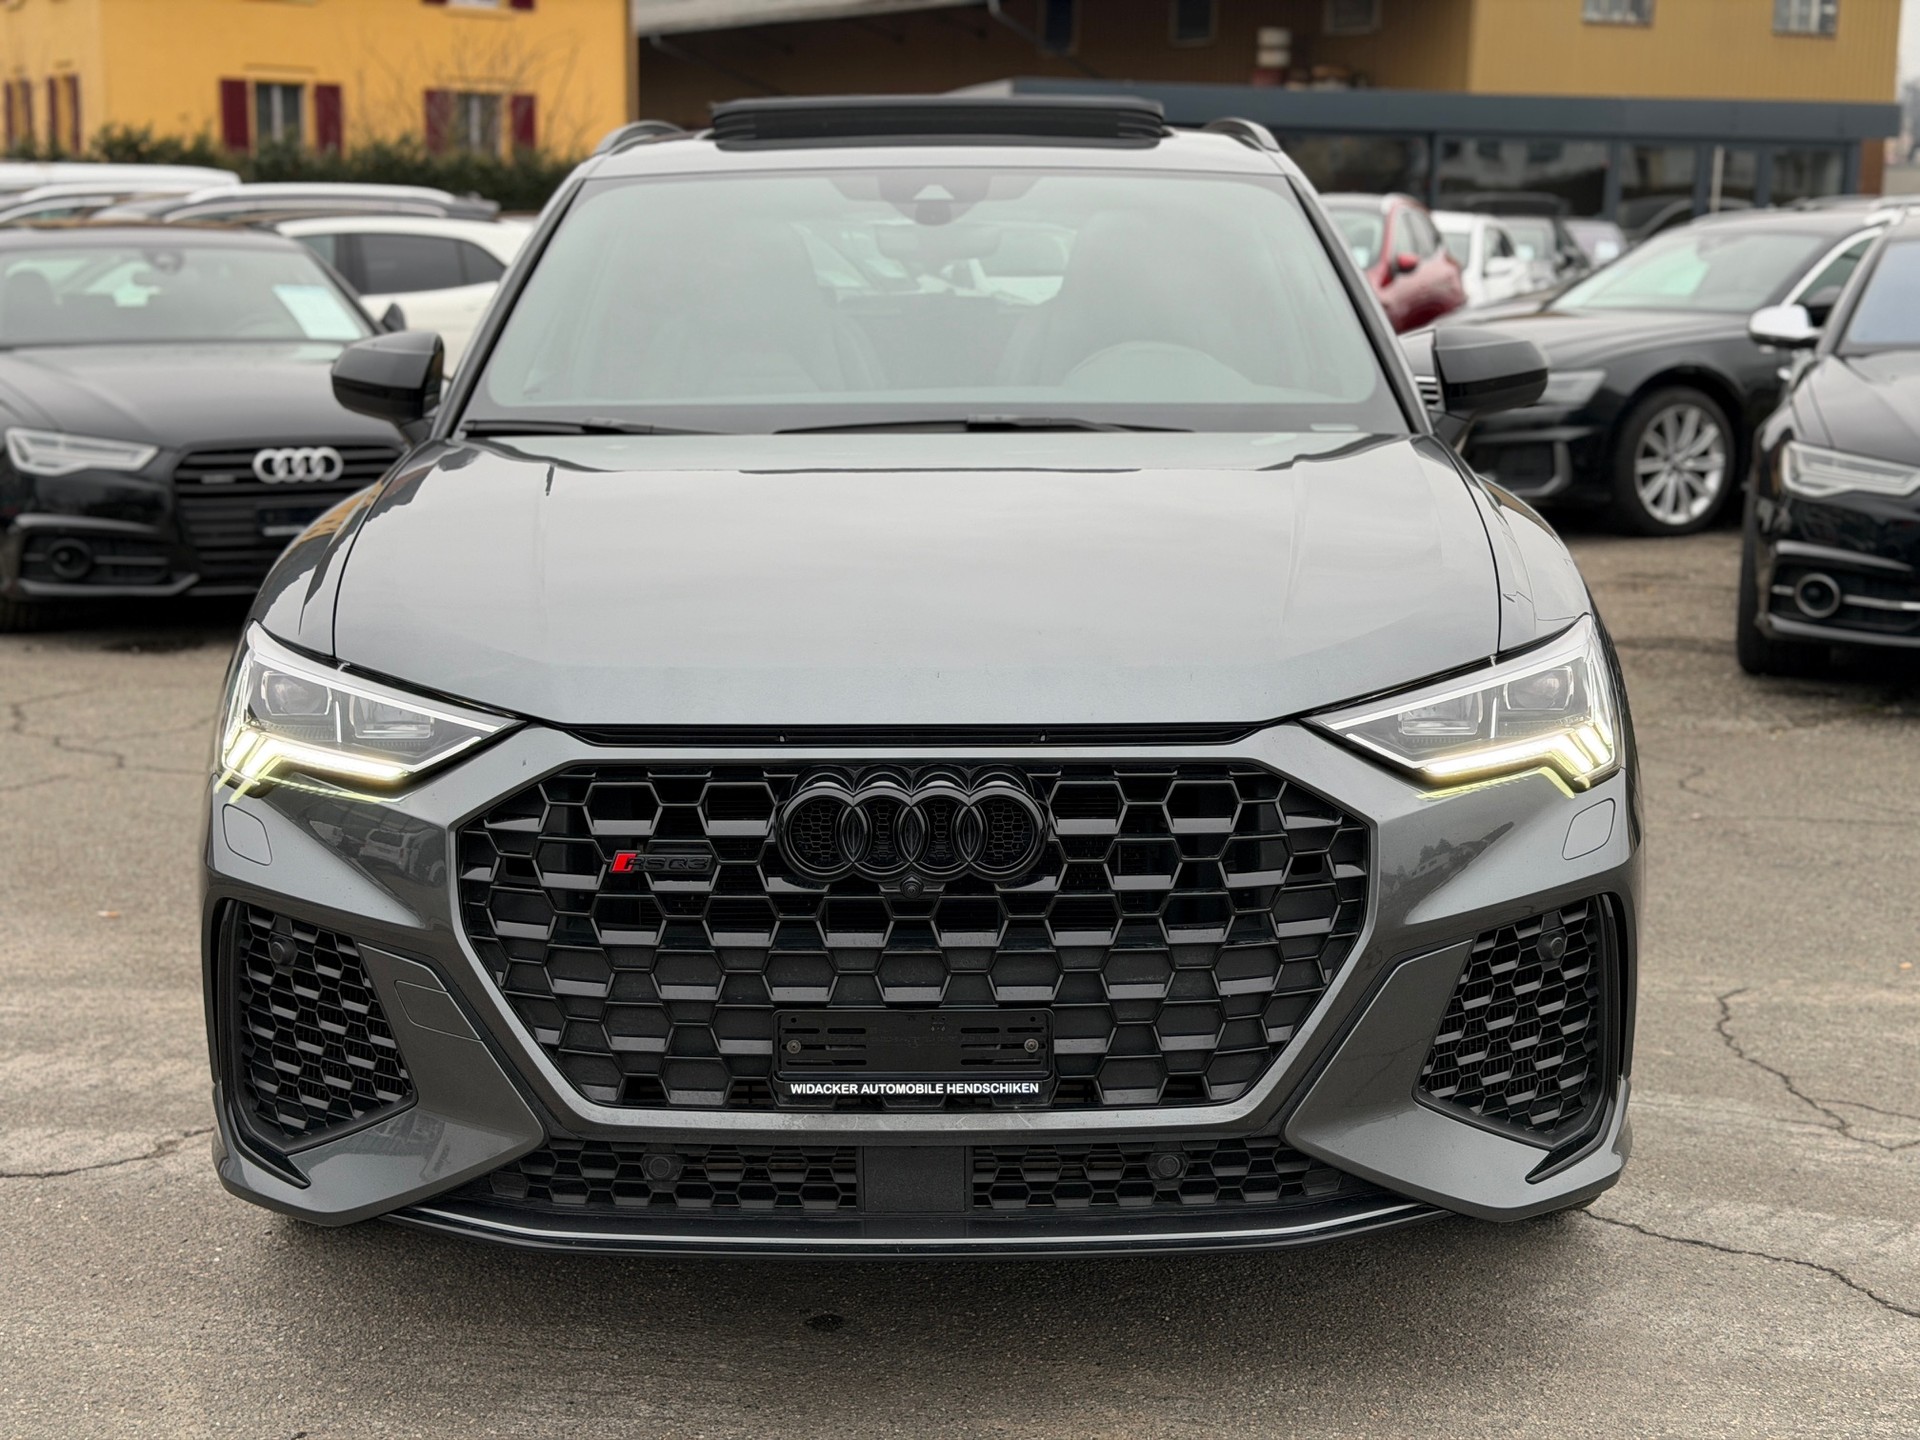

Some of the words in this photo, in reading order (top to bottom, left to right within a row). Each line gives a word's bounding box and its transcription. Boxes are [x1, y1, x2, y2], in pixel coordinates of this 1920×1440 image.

[790, 1083, 858, 1095] WIDACKER
[861, 1083, 944, 1095] AUTOMOBILE
[947, 1082, 1039, 1094] HENDSCHIKEN
